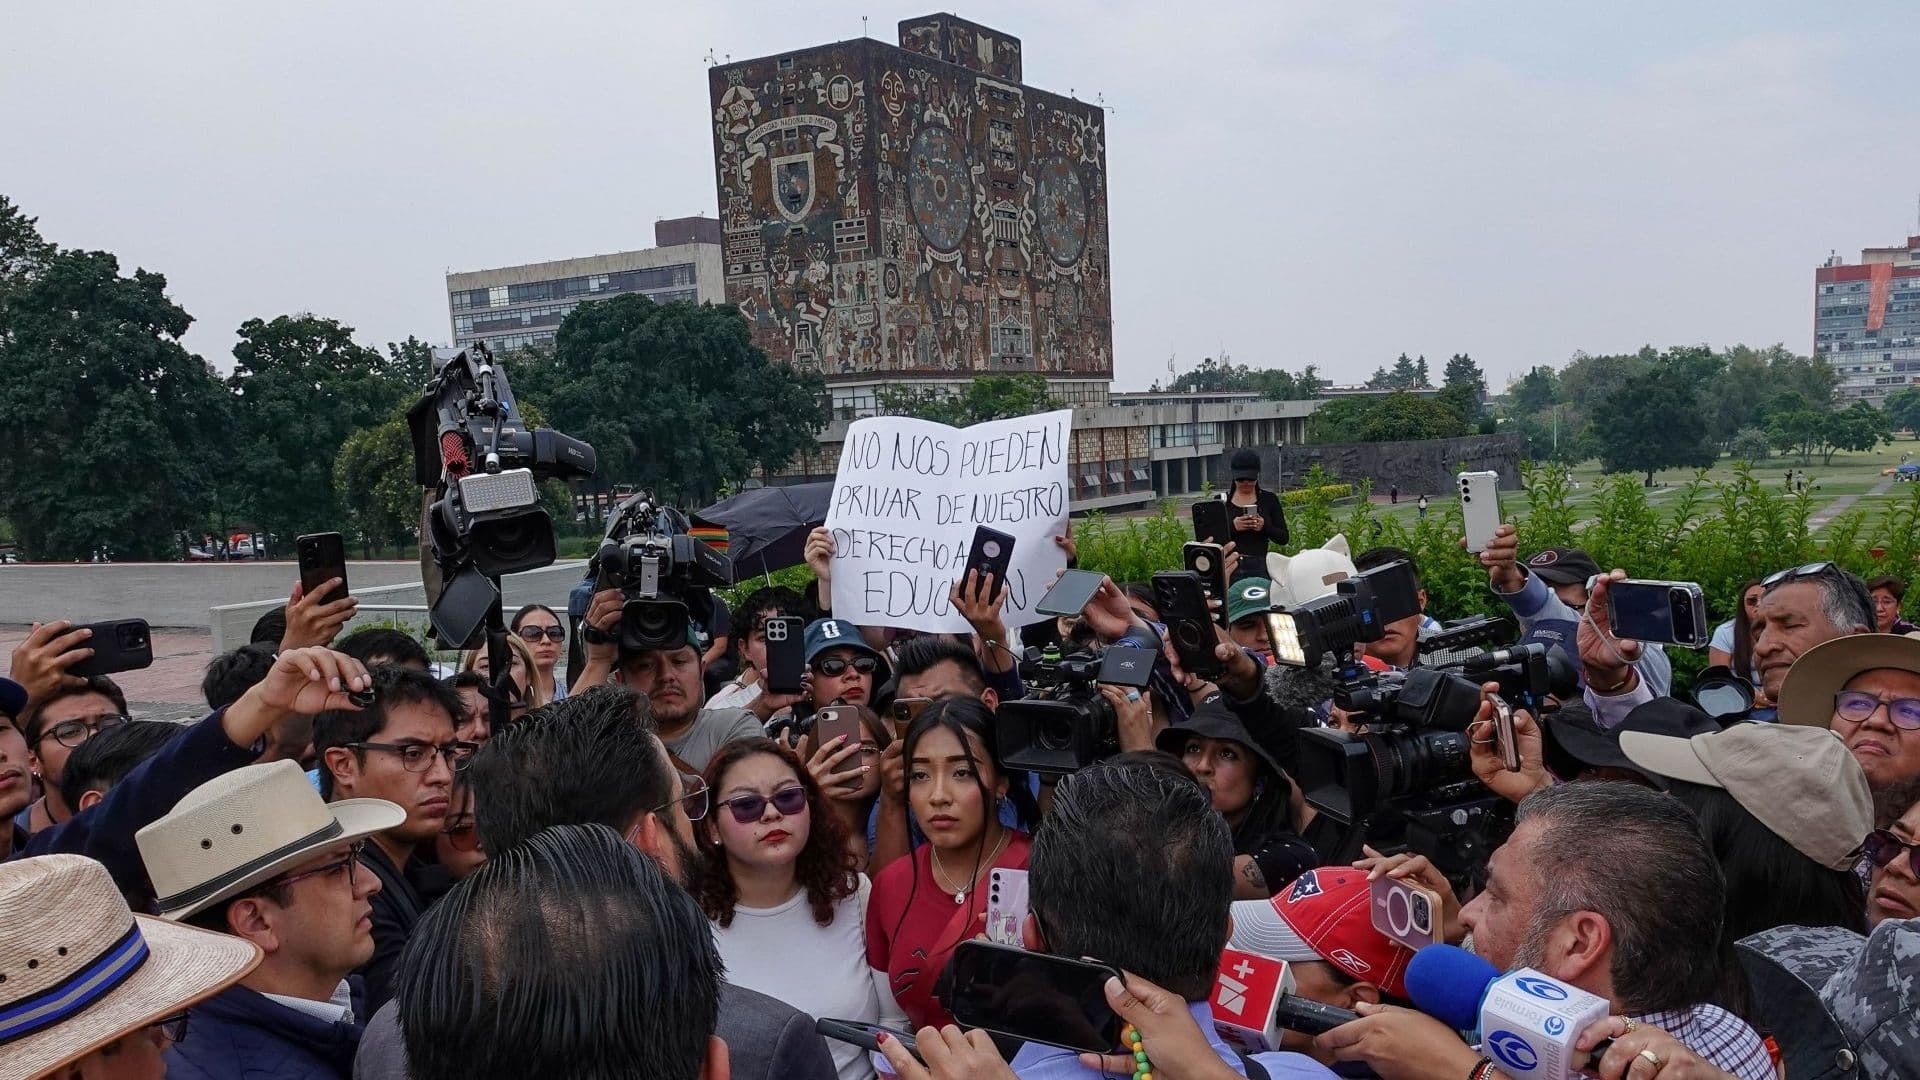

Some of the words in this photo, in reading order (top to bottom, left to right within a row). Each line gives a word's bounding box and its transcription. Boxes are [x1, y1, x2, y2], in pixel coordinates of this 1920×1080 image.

[847, 431, 881, 473] NO
[892, 432, 950, 476] NOS
[960, 421, 1062, 479] PUEDEN
[835, 485, 922, 520] PRIVAR
[937, 493, 966, 525] DE
[970, 481, 1063, 523] NUESTRO
[832, 528, 950, 570] DERECHO
[863, 569, 1027, 618] EDUCN
